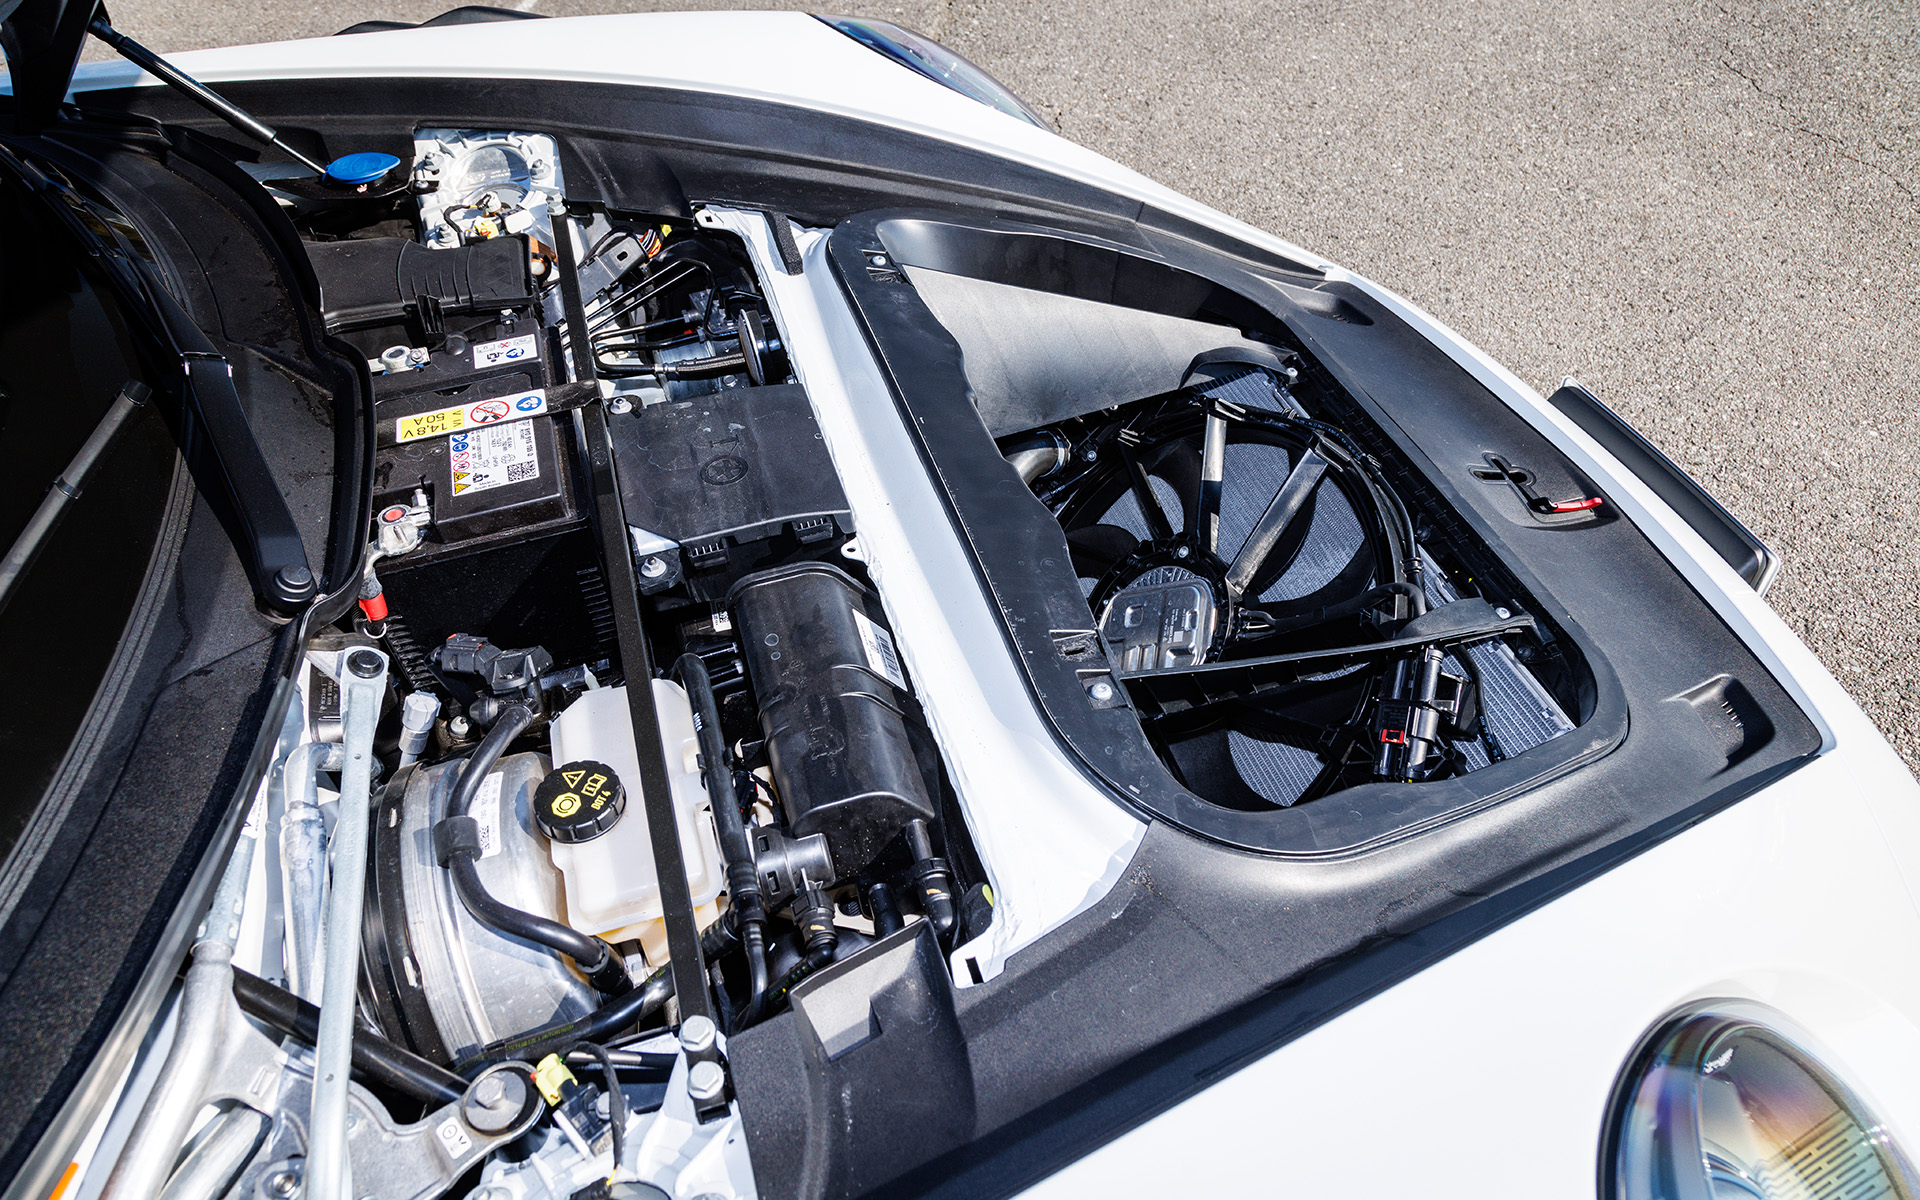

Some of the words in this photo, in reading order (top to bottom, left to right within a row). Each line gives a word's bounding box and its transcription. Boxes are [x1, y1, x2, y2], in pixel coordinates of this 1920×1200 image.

[413, 416, 424, 426] A
[425, 412, 445, 424] 50
[403, 429, 414, 439] V
[591, 794, 607, 811] DOT
[601, 790, 612, 798] 4
